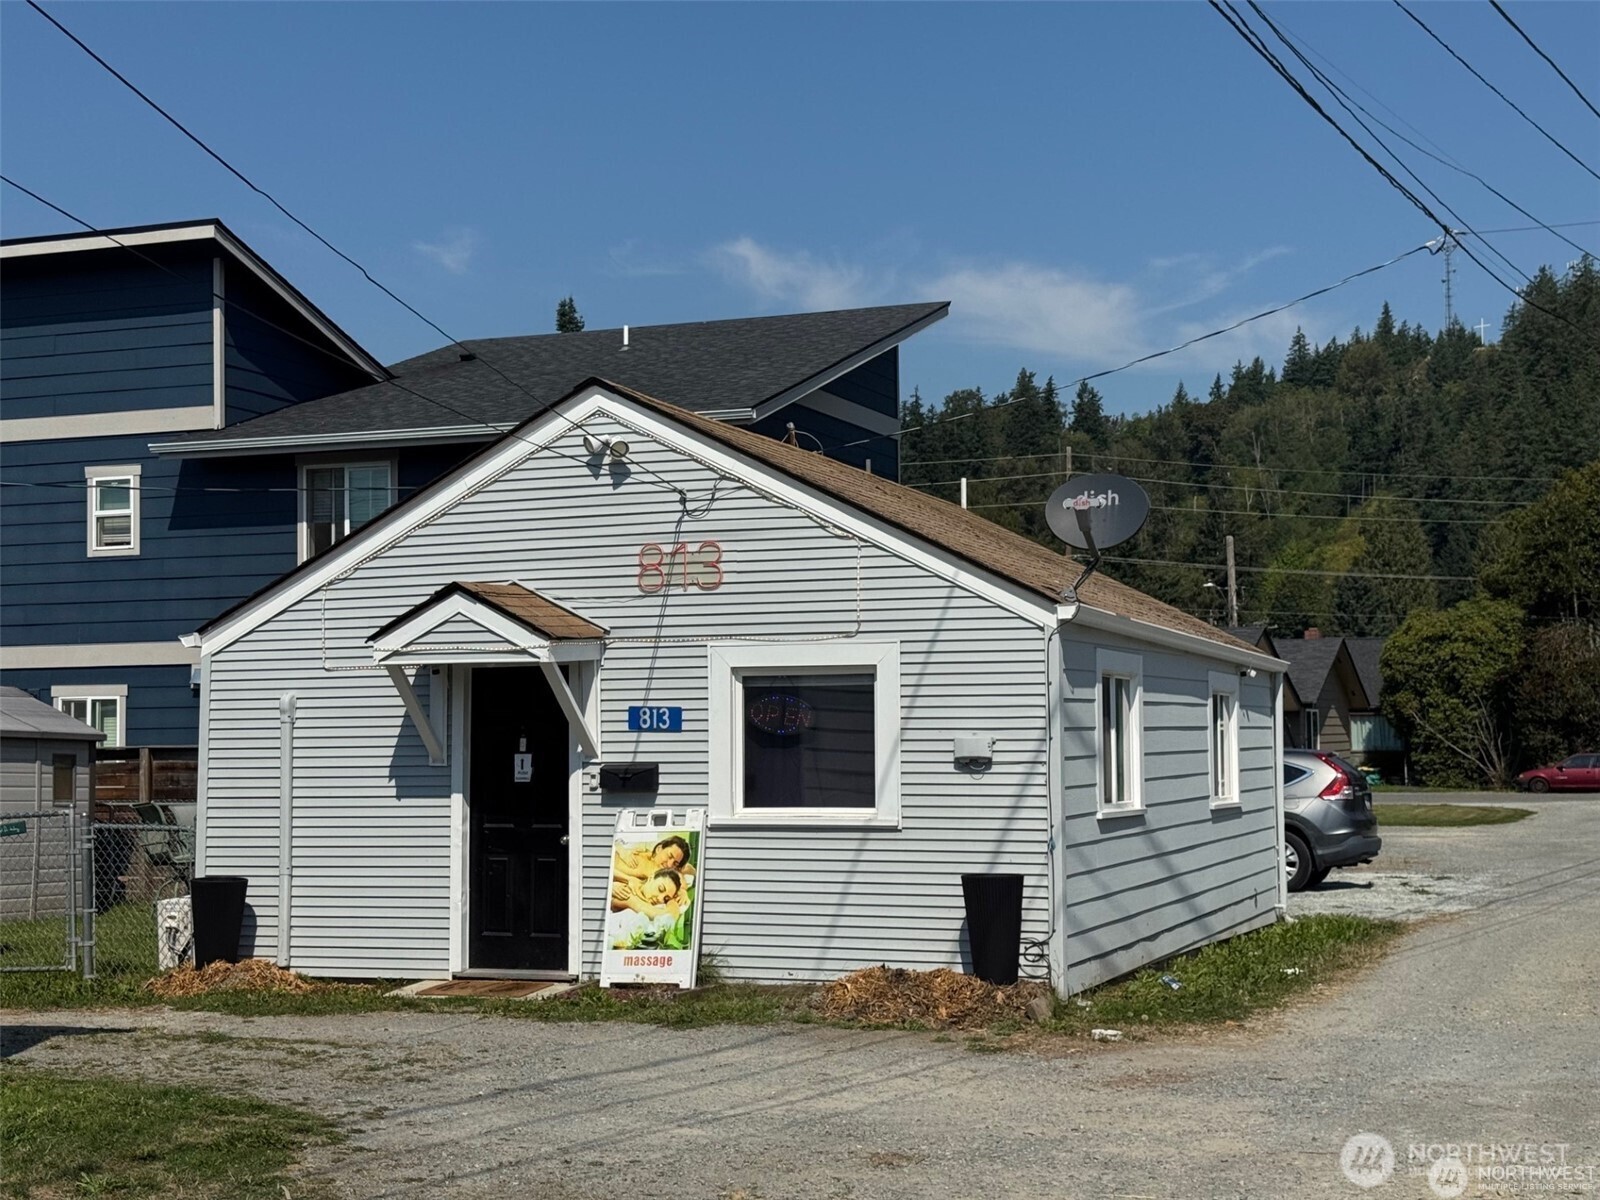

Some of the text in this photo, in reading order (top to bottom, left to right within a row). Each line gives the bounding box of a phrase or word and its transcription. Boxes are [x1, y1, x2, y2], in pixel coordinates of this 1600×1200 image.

[638, 540, 723, 594] 813
[639, 707, 670, 729] 813
[750, 703, 813, 728] OPEN
[623, 956, 673, 968] massage
